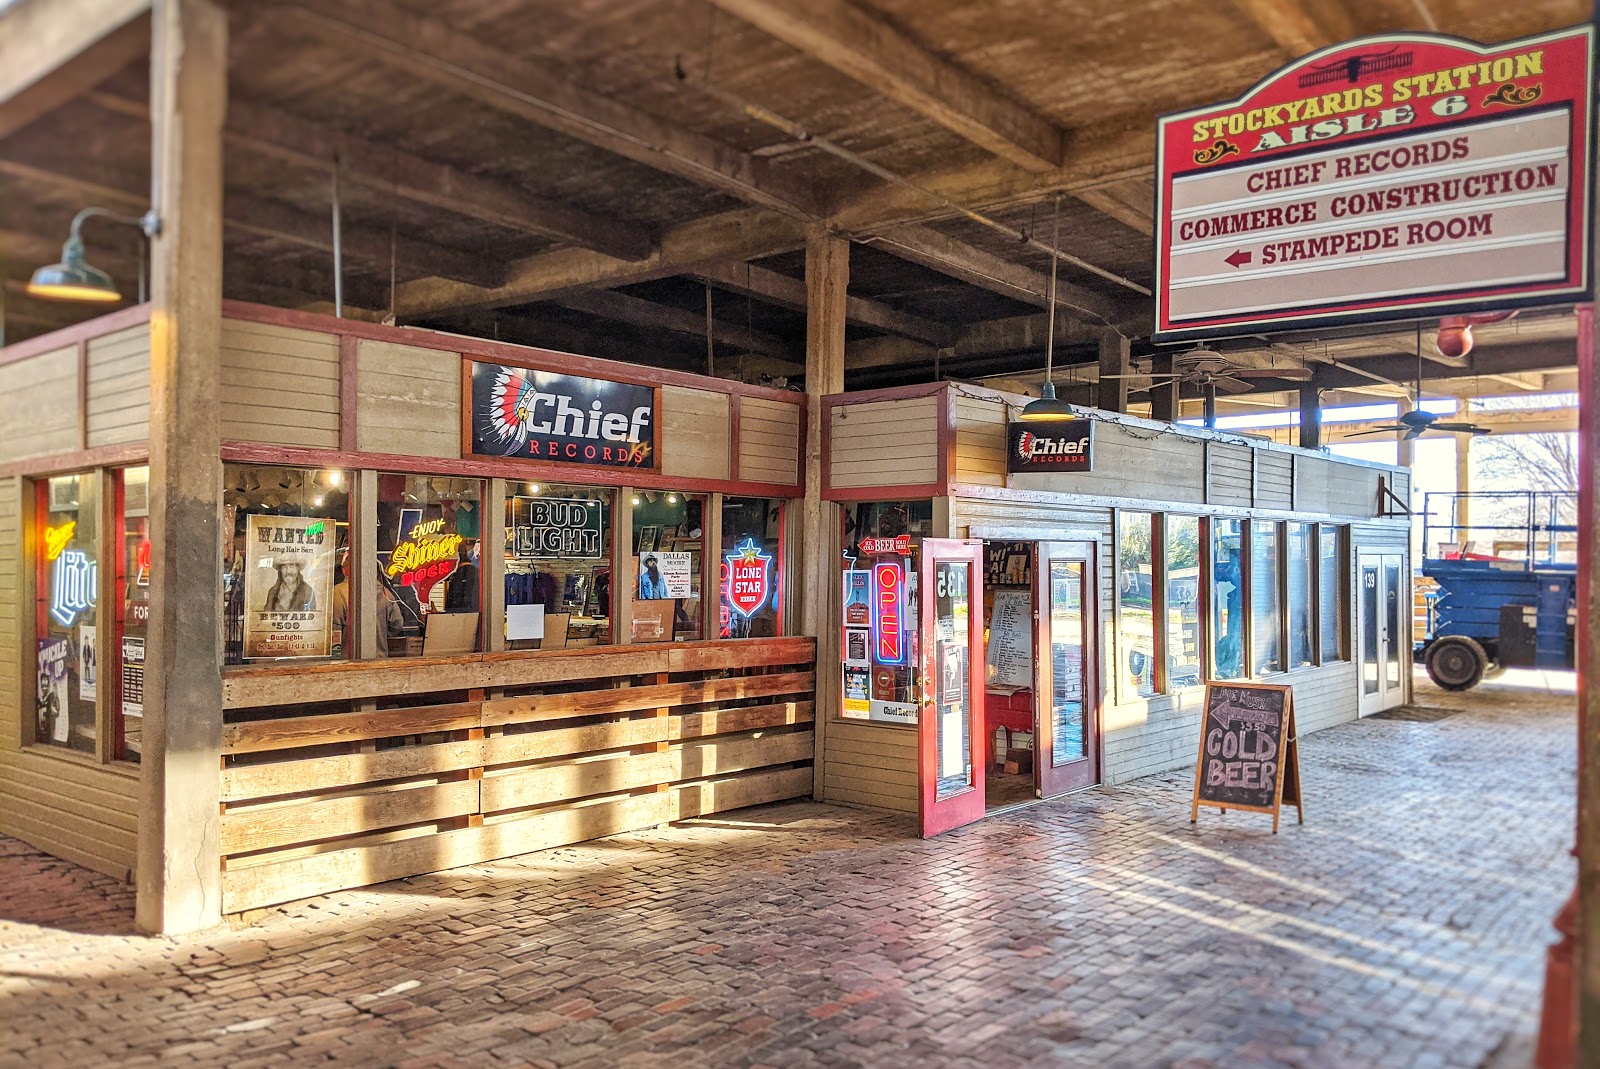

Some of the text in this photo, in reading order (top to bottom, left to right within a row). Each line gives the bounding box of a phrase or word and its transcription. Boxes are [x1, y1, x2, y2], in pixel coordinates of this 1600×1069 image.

[1193, 51, 1544, 142] STOCKYARDS STATION
[1251, 95, 1469, 152] AISLE 6
[1247, 137, 1469, 192] CHIEF RECORDS
[1180, 164, 1558, 241] COMMERCE CONSTRUCTION
[1262, 213, 1492, 265] STAMPEDE ROOM
[527, 392, 651, 443] Chief
[529, 440, 643, 463] RECORDS
[1032, 437, 1089, 455] Chief
[530, 501, 588, 528] BUD
[409, 518, 446, 539] ENJOY
[517, 525, 599, 552] LIGHT
[268, 546, 285, 554] Long
[388, 534, 463, 576] Shiner
[875, 539, 895, 551] BEER
[401, 561, 450, 587] BOCK
[735, 581, 761, 593] STAR
[736, 568, 762, 579] LONE
[1364, 572, 1375, 588] 139
[879, 568, 899, 658] OPEN
[1207, 728, 1277, 760] COLD
[1207, 759, 1277, 792] BEER
